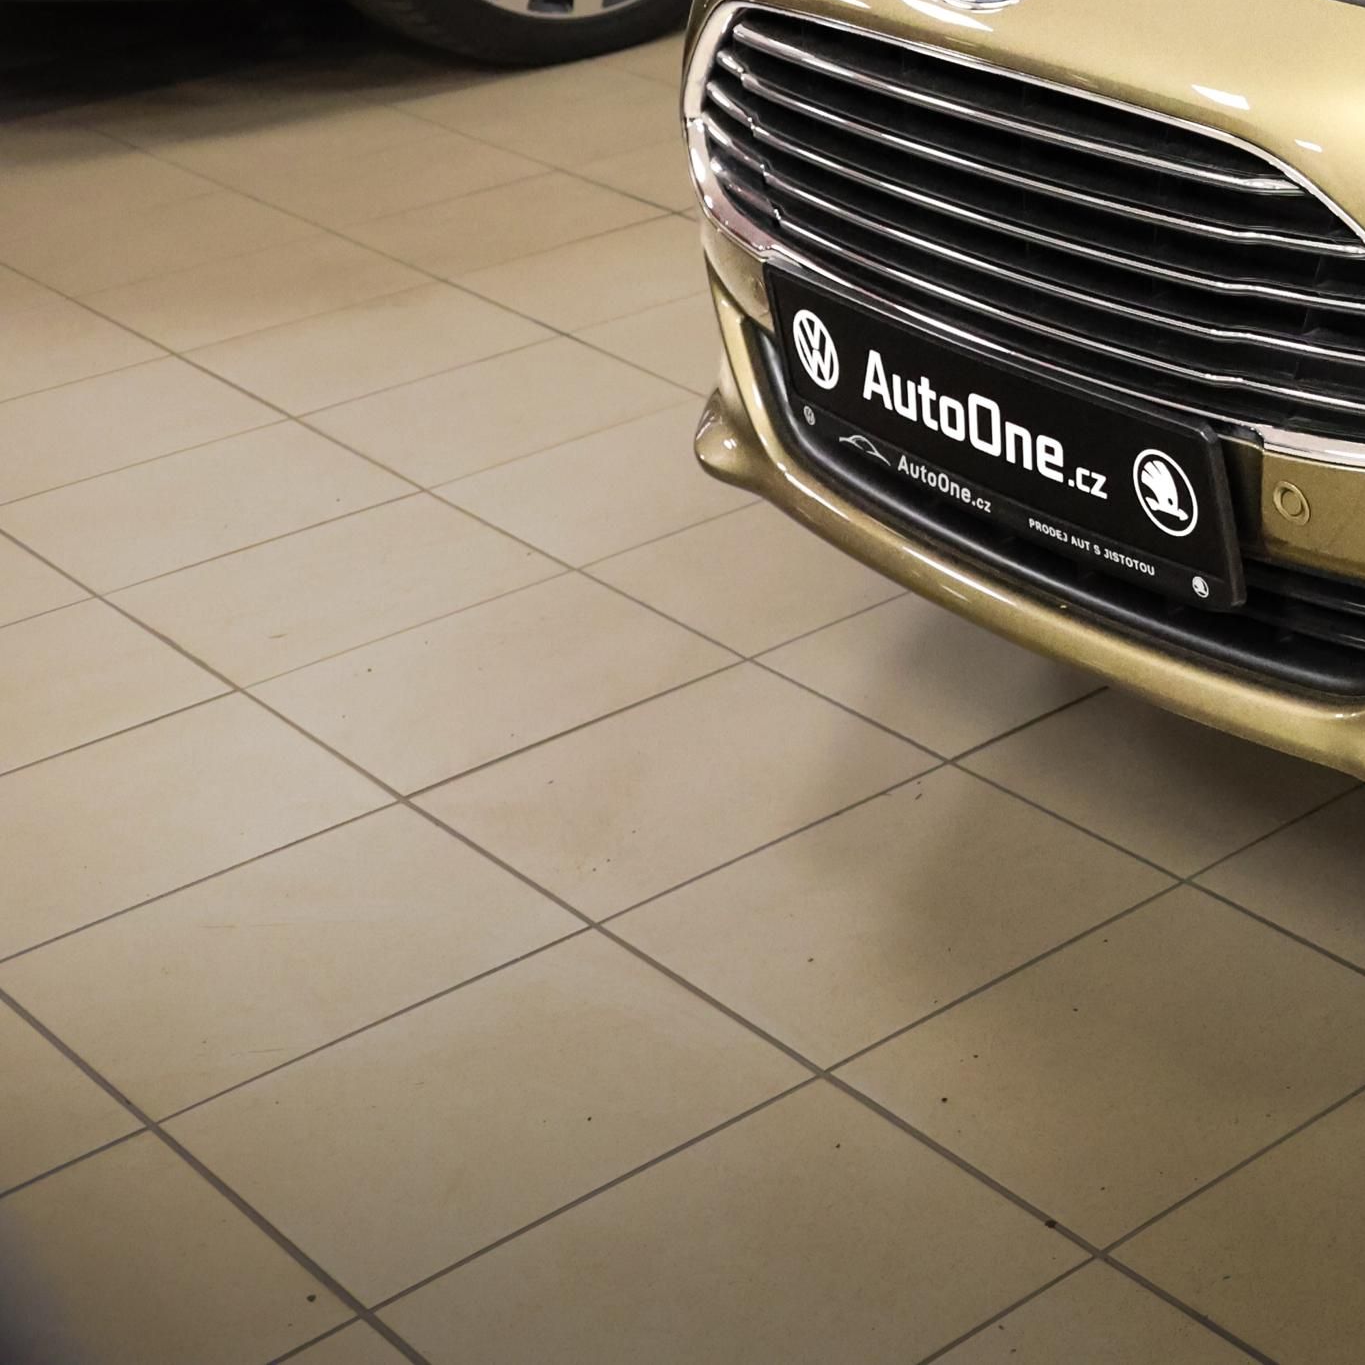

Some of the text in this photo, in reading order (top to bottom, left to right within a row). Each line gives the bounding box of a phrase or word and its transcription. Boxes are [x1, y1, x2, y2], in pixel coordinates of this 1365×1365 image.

[862, 348, 1108, 500] AutoOne.cz
[897, 454, 993, 514] AutoOne.cz
[1028, 518, 1156, 577] PRODEJ AUT S JISTOTOU
